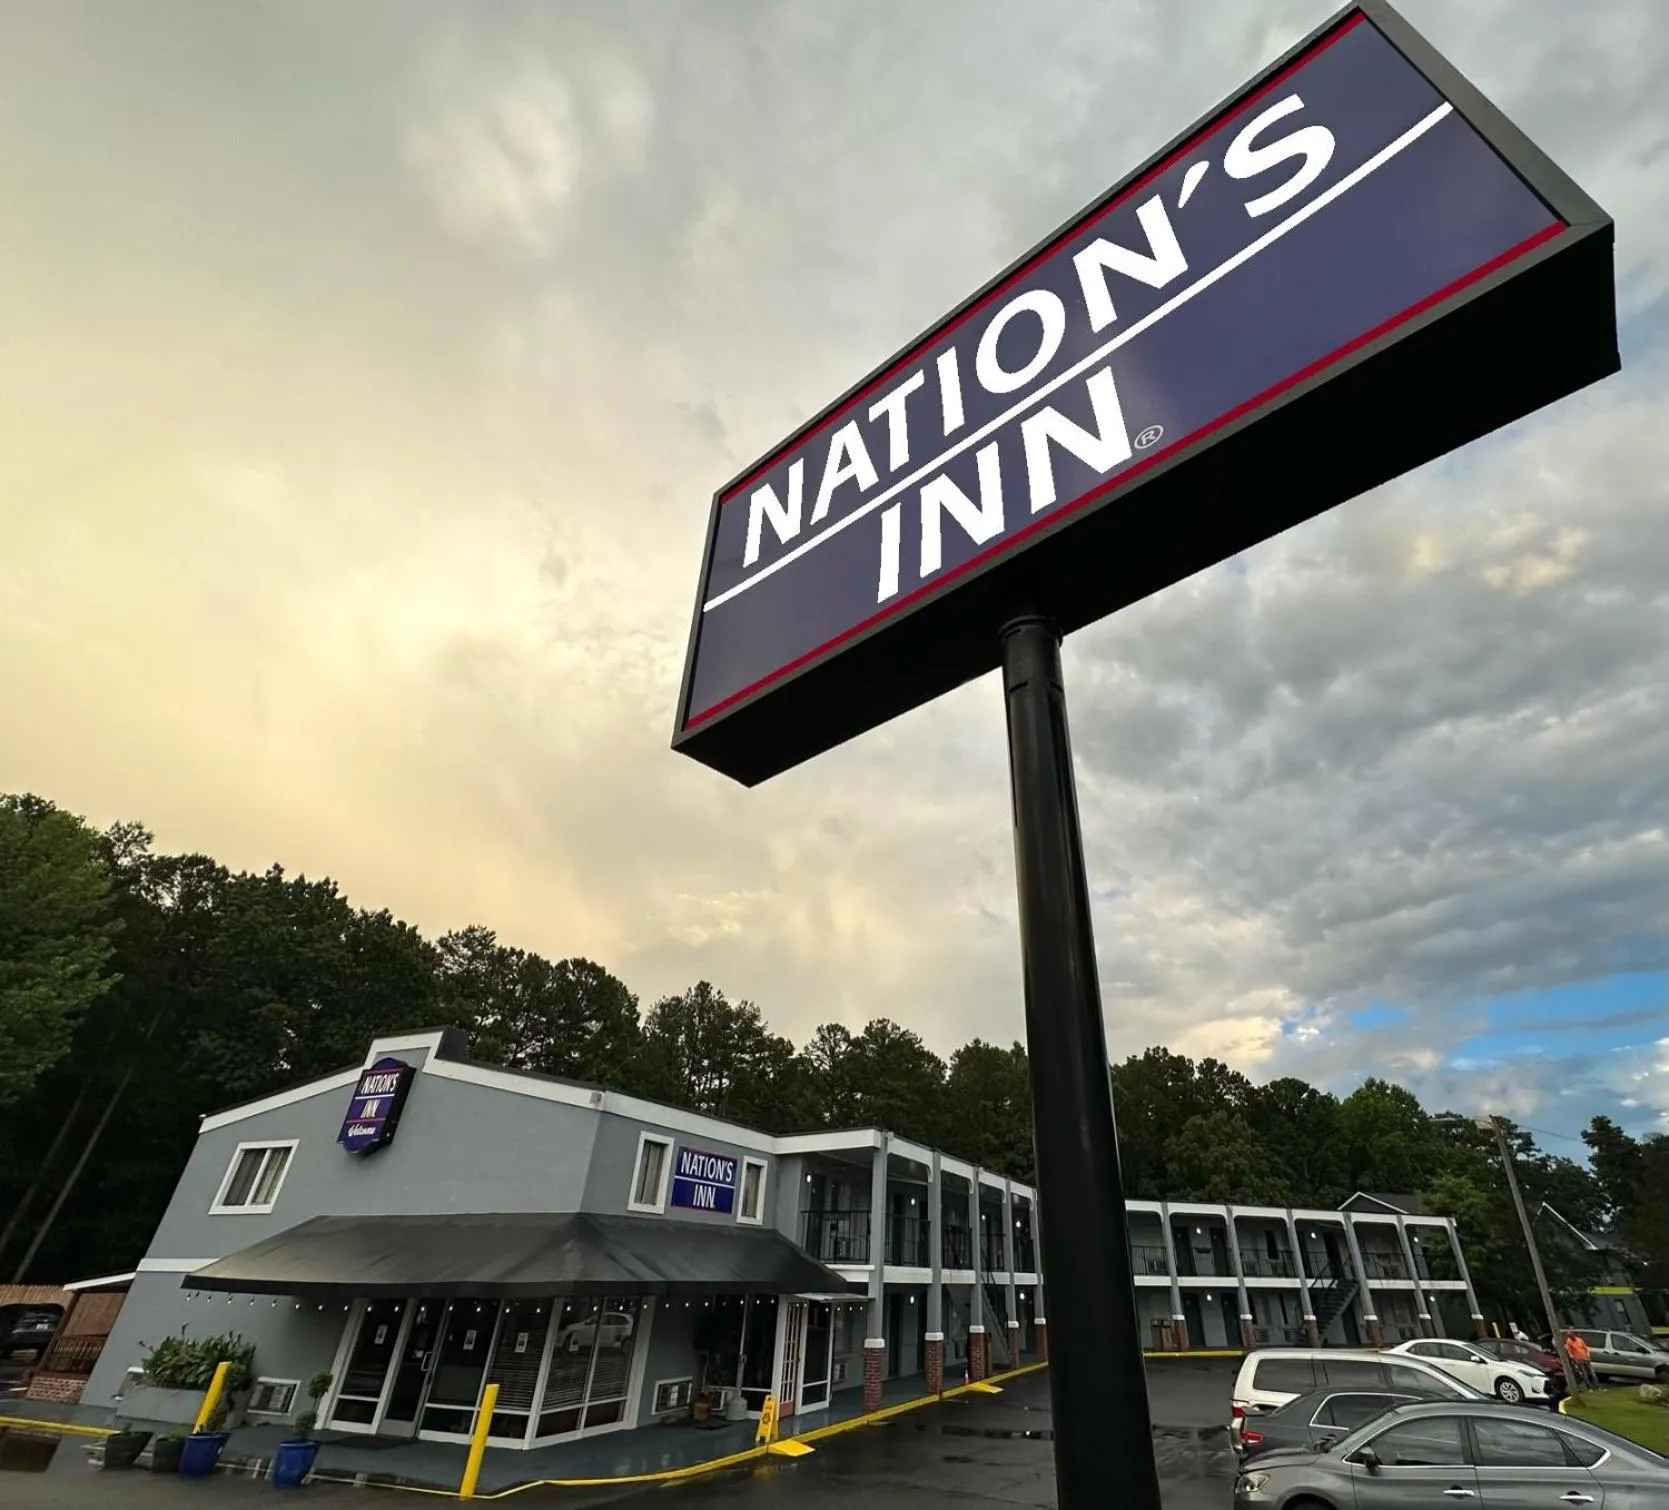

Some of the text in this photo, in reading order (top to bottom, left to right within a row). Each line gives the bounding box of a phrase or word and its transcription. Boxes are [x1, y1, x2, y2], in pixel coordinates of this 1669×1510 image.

[742, 94, 1335, 567] NATION'S
[877, 365, 1131, 602] INN
[361, 1073, 399, 1094] NATION'S
[361, 1099, 380, 1118] INN
[681, 1151, 734, 1182] NATION'S
[693, 1184, 716, 1208] INN
